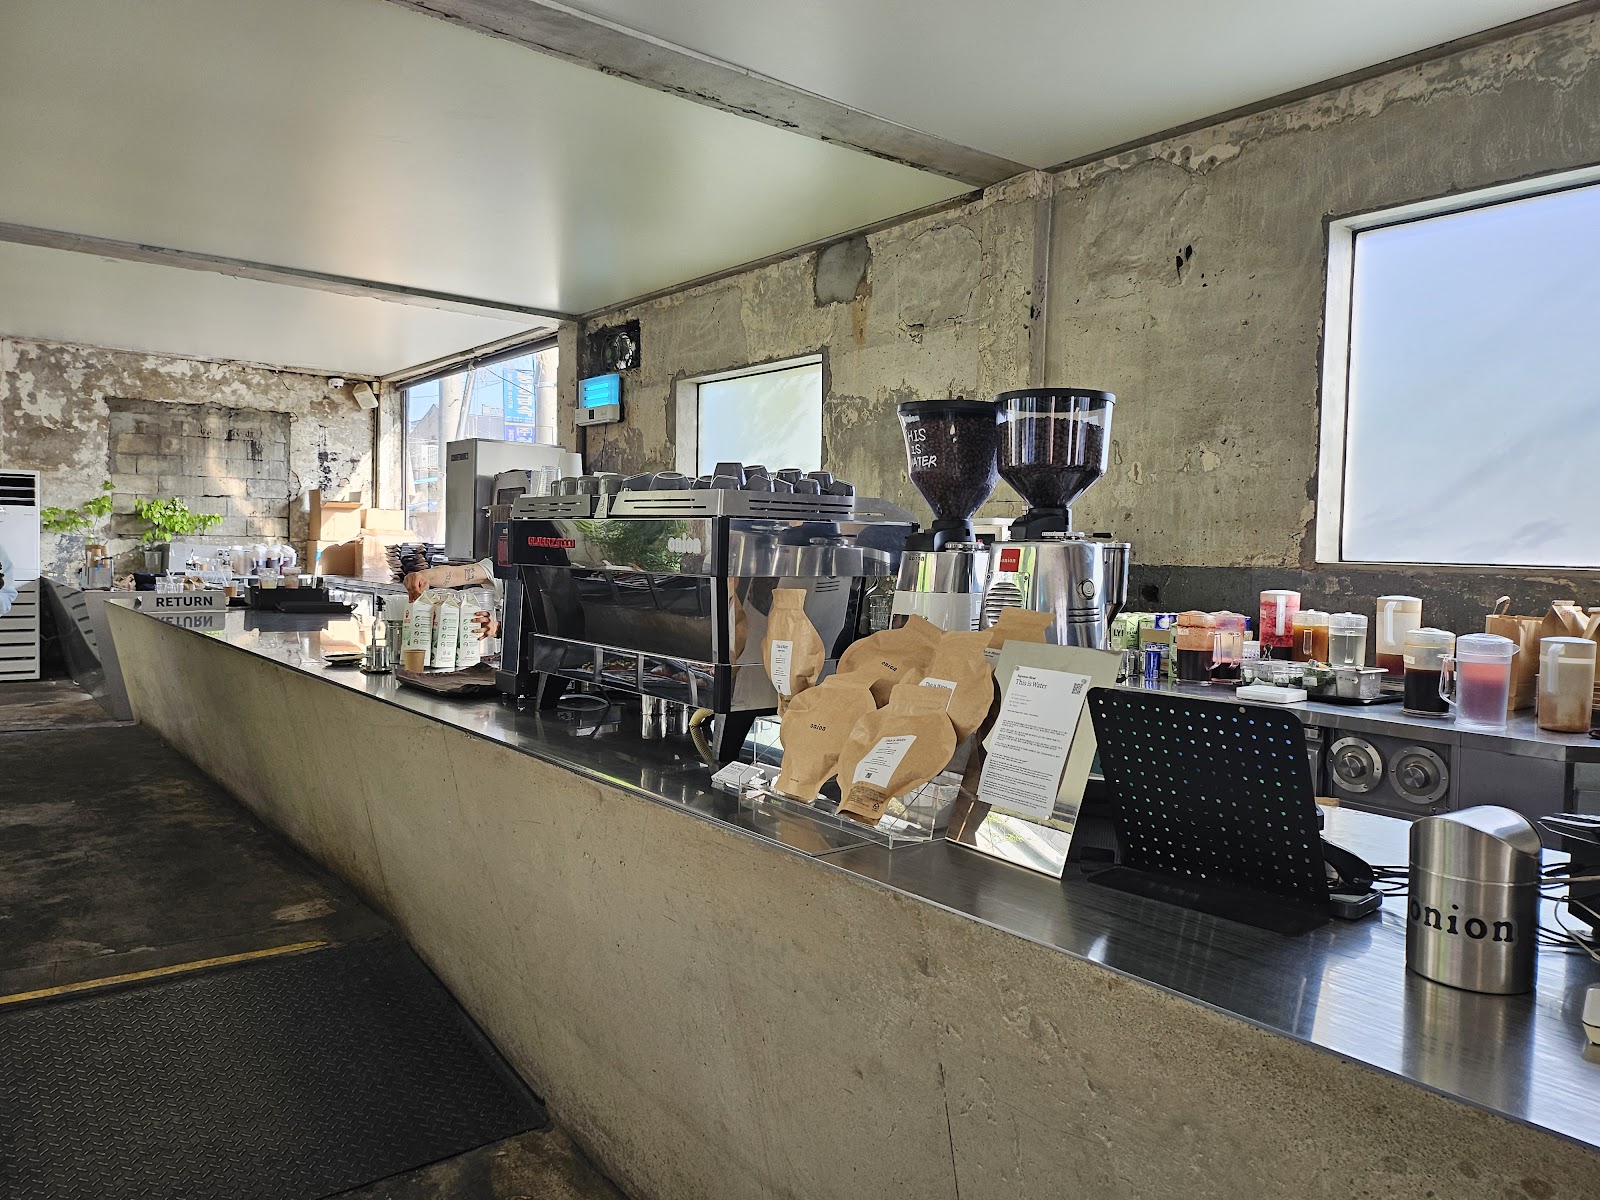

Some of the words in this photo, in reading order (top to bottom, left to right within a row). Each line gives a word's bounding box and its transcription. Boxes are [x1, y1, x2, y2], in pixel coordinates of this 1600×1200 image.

[907, 428, 926, 442] HIS
[911, 445, 922, 454] IS
[912, 455, 937, 468] ATER
[156, 596, 213, 607] RETURN
[1015, 678, 1027, 687] This
[1032, 681, 1048, 689] Water
[1410, 900, 1514, 943] onion
